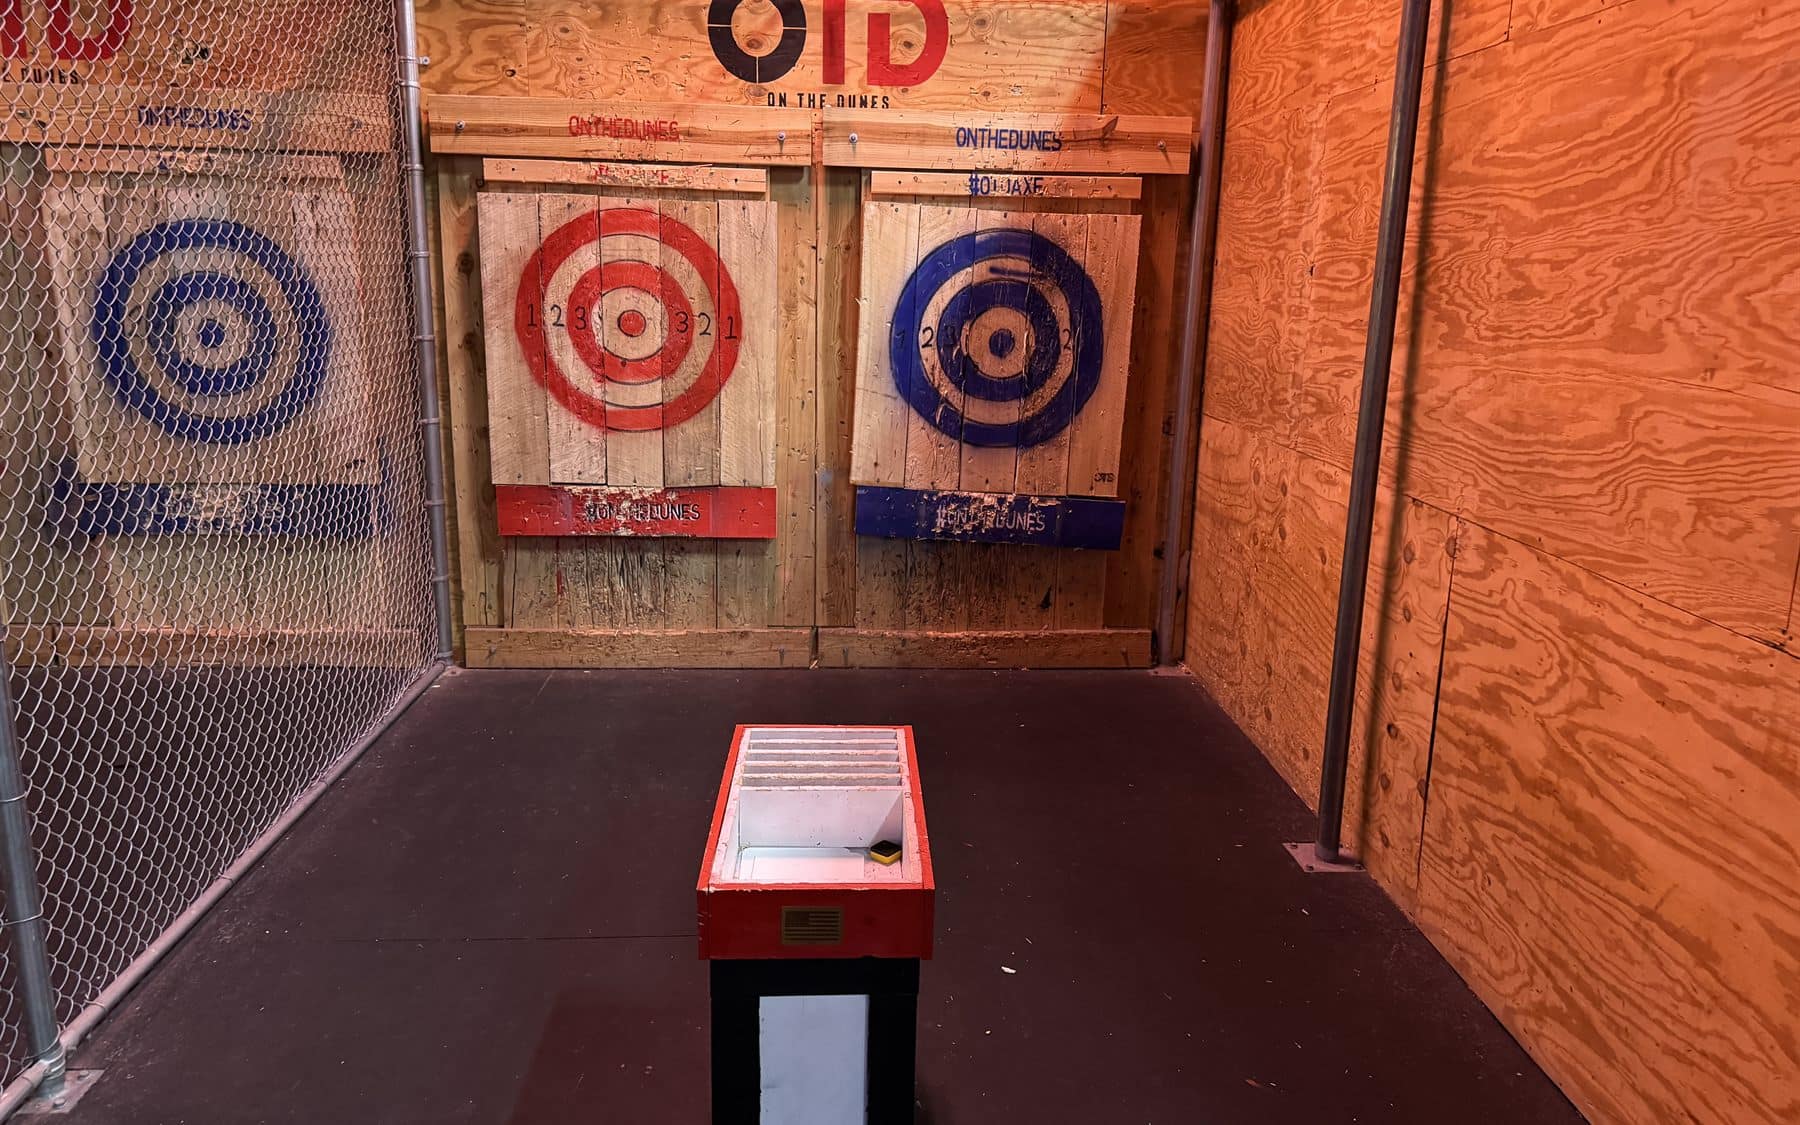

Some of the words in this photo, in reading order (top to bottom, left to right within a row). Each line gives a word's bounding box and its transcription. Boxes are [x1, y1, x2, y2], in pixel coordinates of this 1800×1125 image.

[767, 92, 787, 107] ON
[797, 93, 827, 109] THE
[837, 94, 889, 109] DUNES
[568, 115, 680, 142] ONTHEDUNES
[956, 127, 1063, 151] ONTHEDUNES
[527, 303, 538, 327] 1
[550, 304, 565, 327] 2
[575, 305, 587, 330] 3
[675, 311, 689, 333] 3
[699, 312, 712, 336] 2
[724, 315, 737, 339] 1
[921, 326, 934, 349] 2
[1062, 328, 1072, 350] 2
